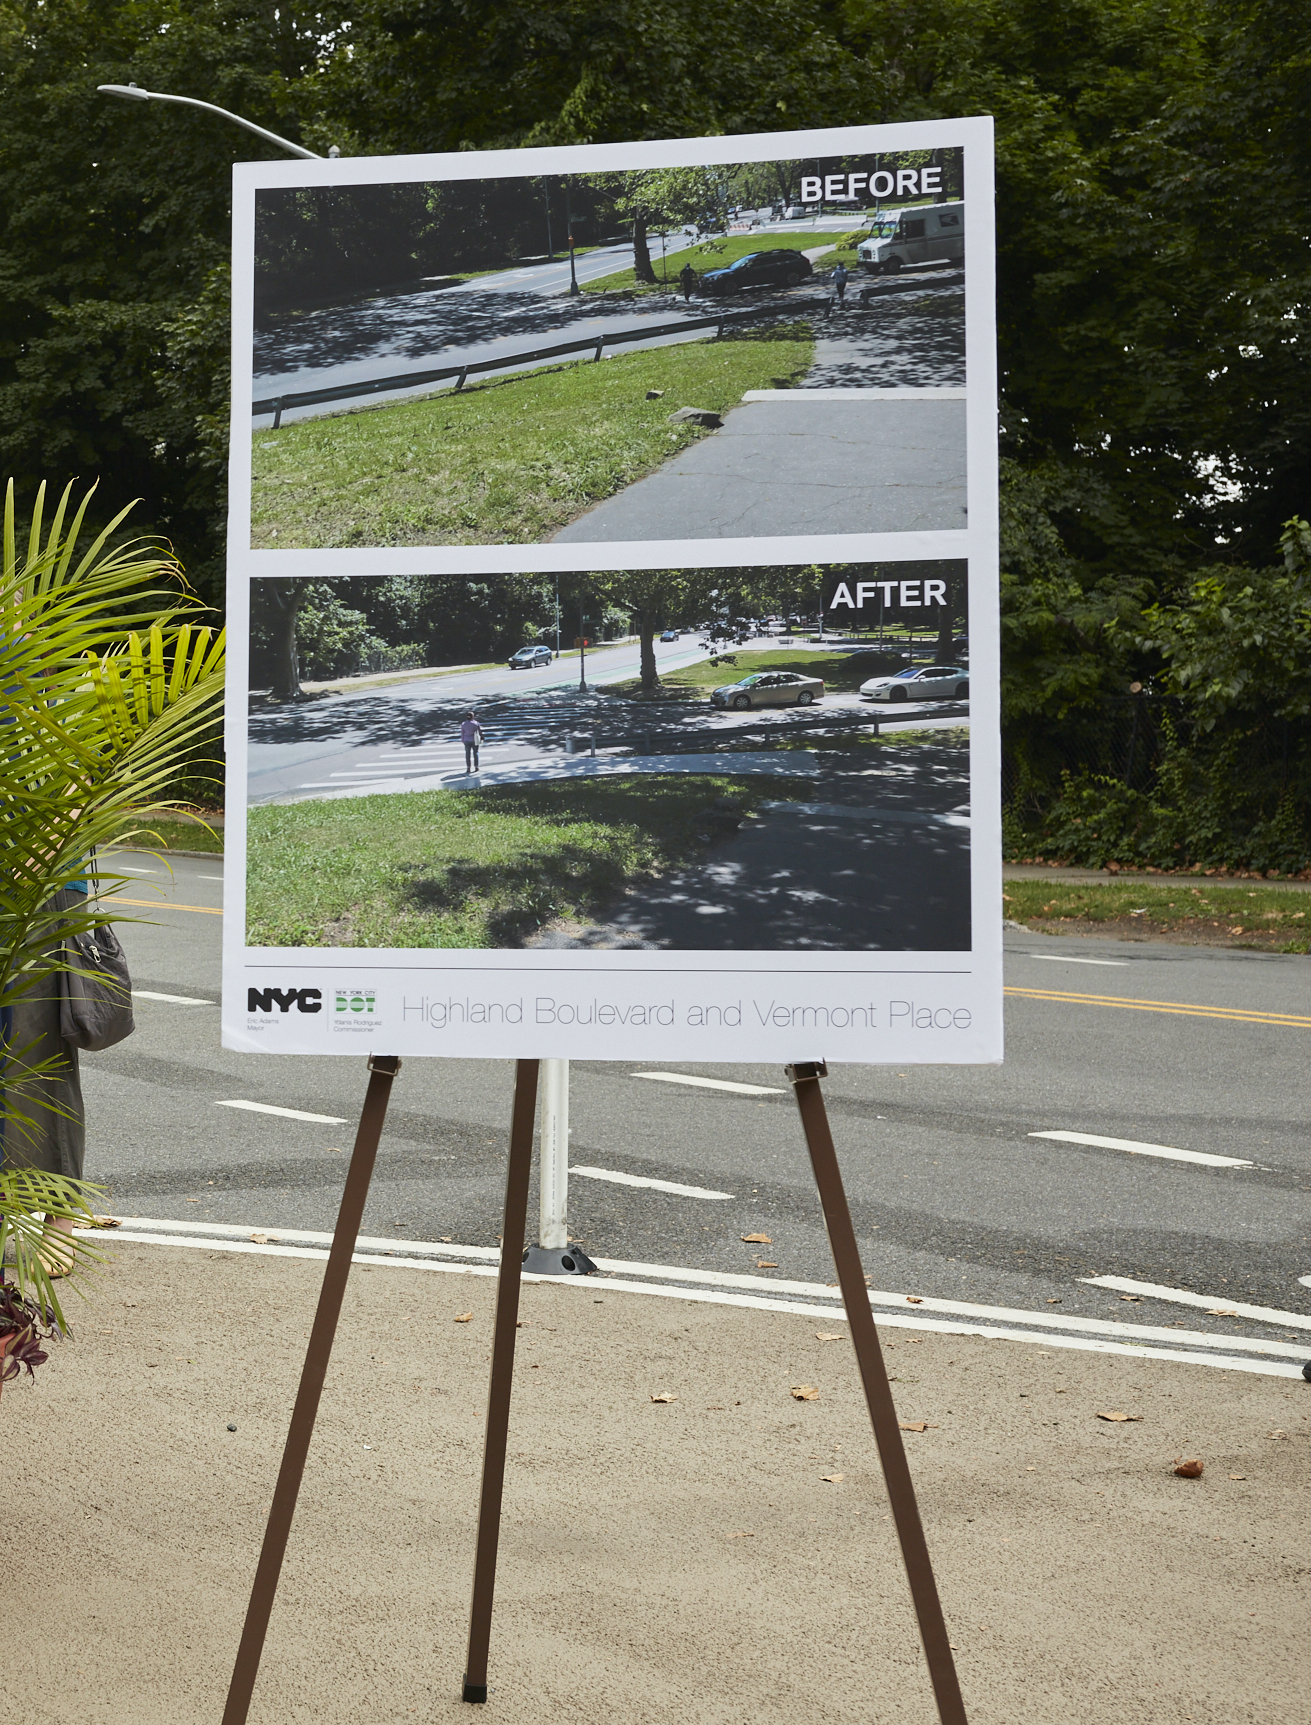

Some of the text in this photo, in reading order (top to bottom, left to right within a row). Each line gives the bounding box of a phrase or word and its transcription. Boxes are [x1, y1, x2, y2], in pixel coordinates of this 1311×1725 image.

[801, 167, 943, 203] BEFORE
[830, 579, 947, 609] AFTER
[247, 987, 322, 1013] NYC
[336, 996, 376, 1013] DOT
[402, 996, 972, 1029] Highland Boulevard and Vermont Place
